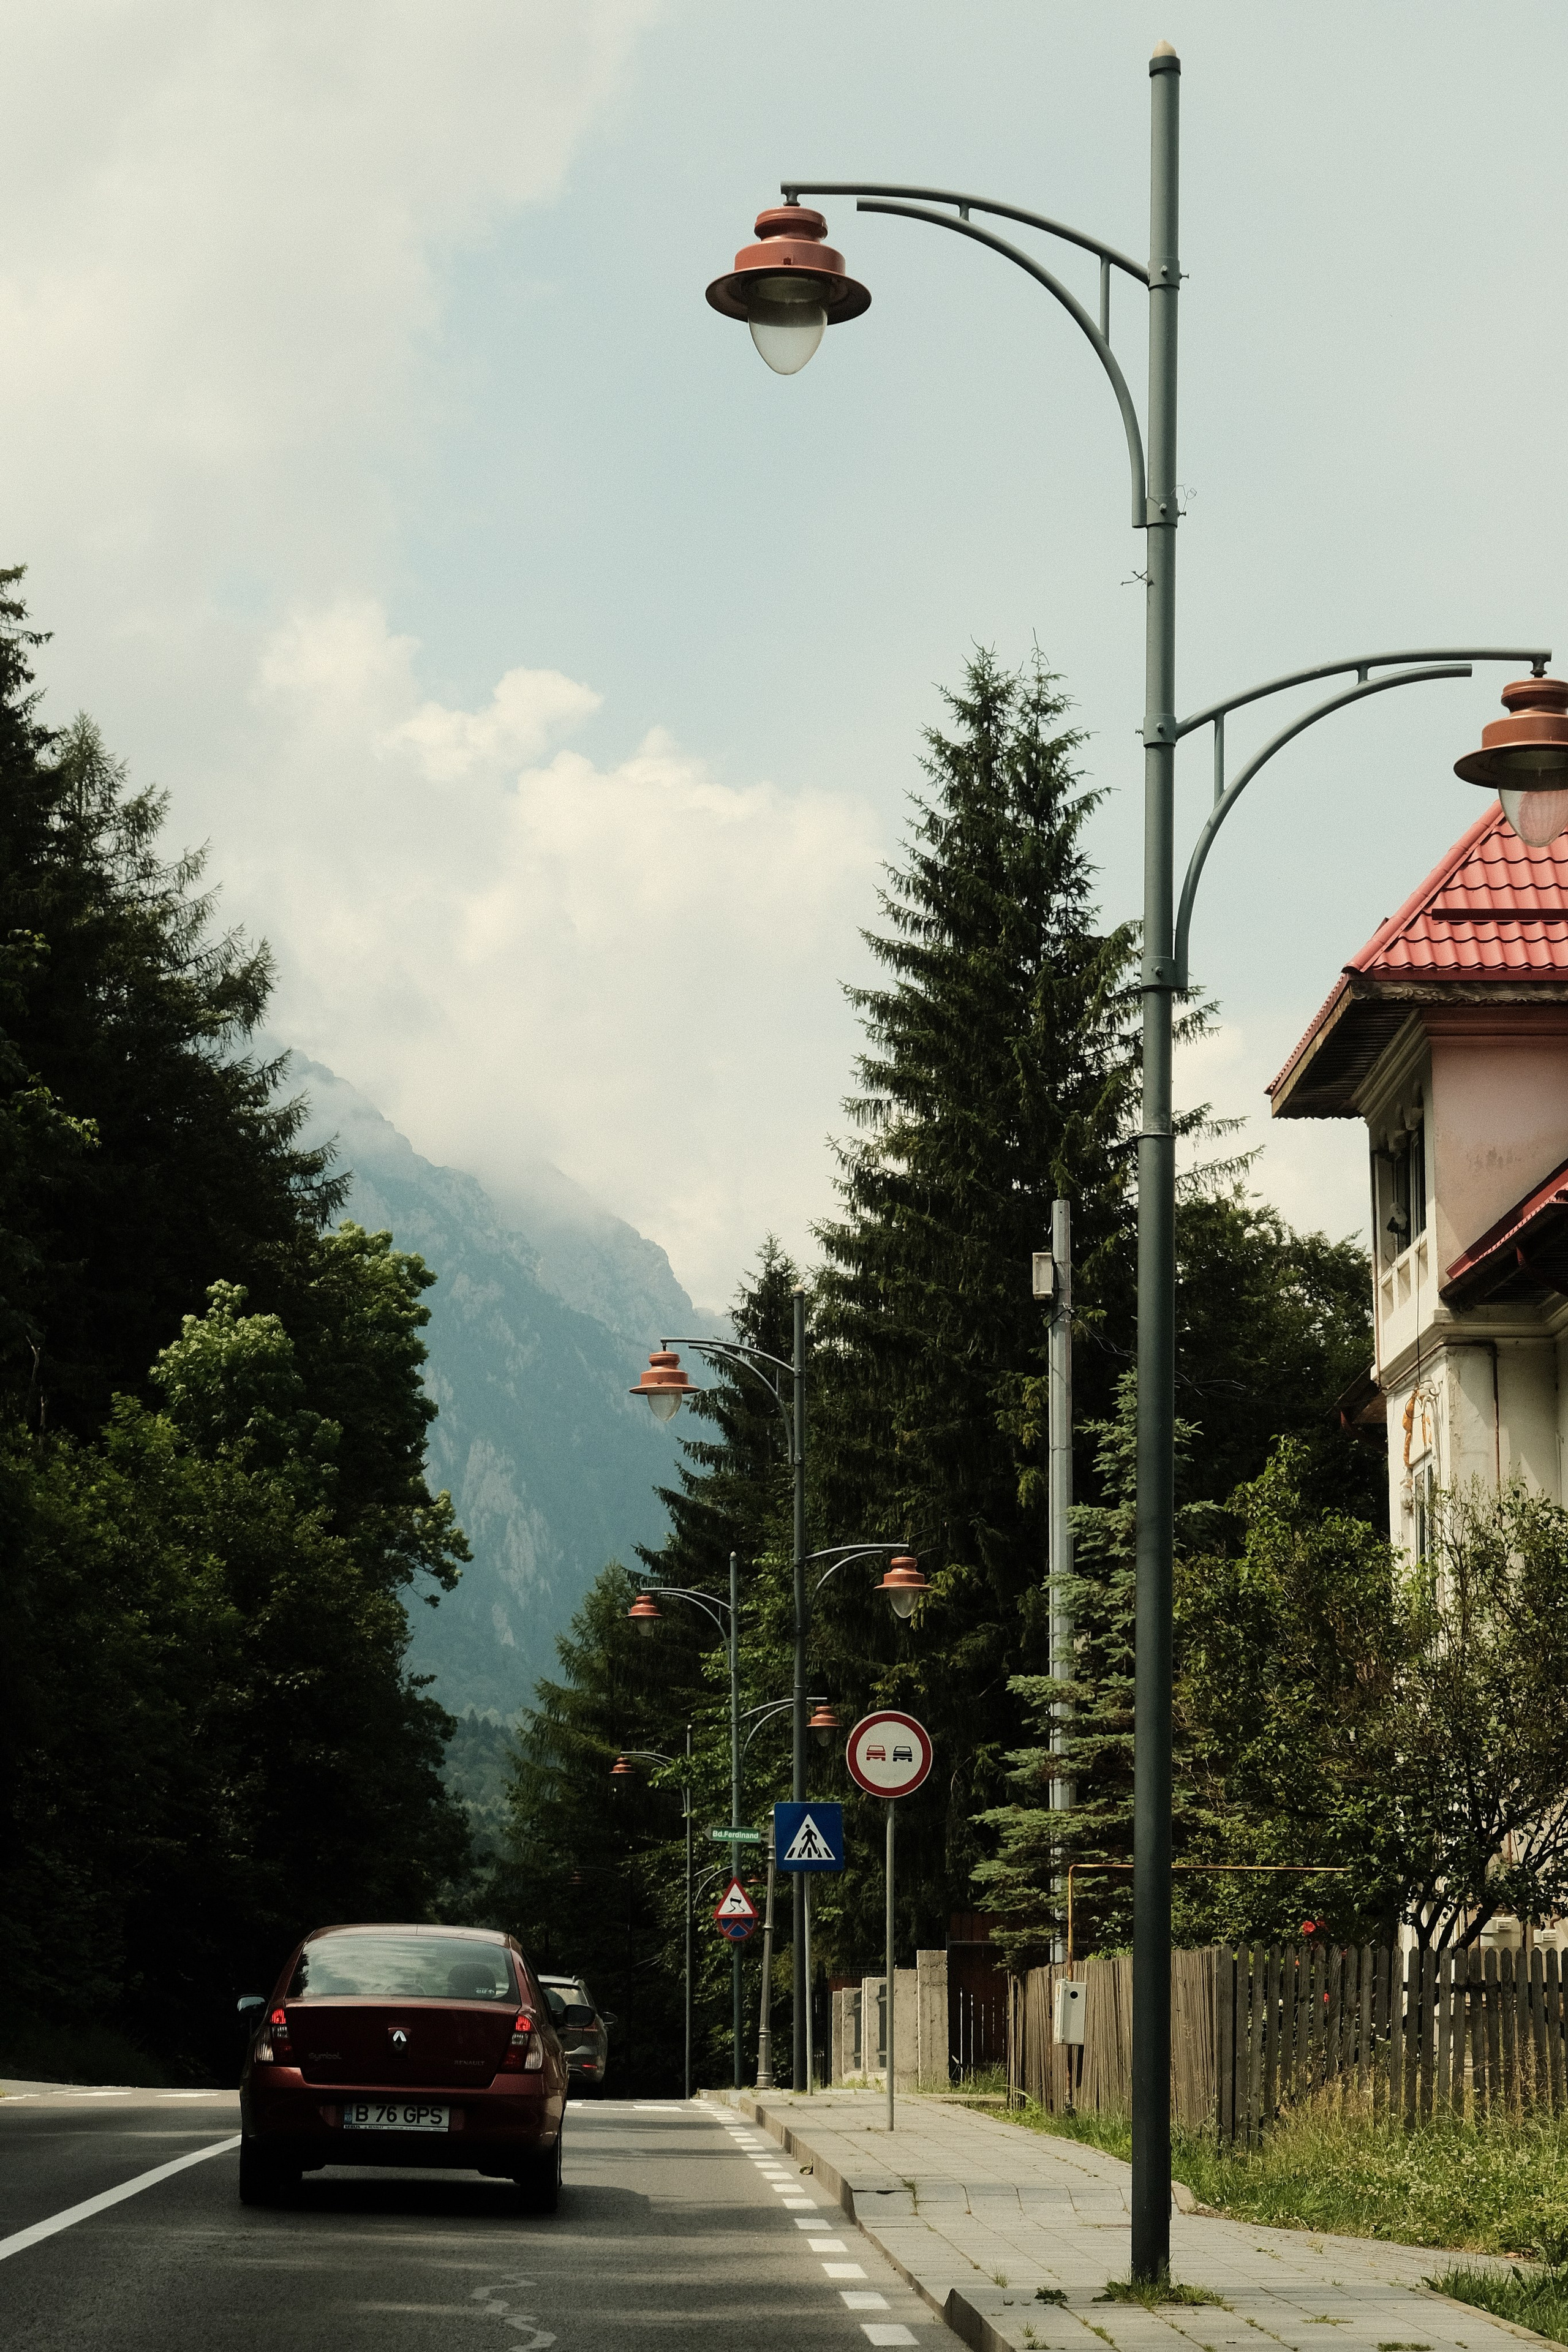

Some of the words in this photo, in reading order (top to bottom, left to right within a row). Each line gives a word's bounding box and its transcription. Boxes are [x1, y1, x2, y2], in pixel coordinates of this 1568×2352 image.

[355, 2105, 369, 2122] B
[375, 2105, 398, 2123] 76
[403, 2106, 443, 2125] GPS
